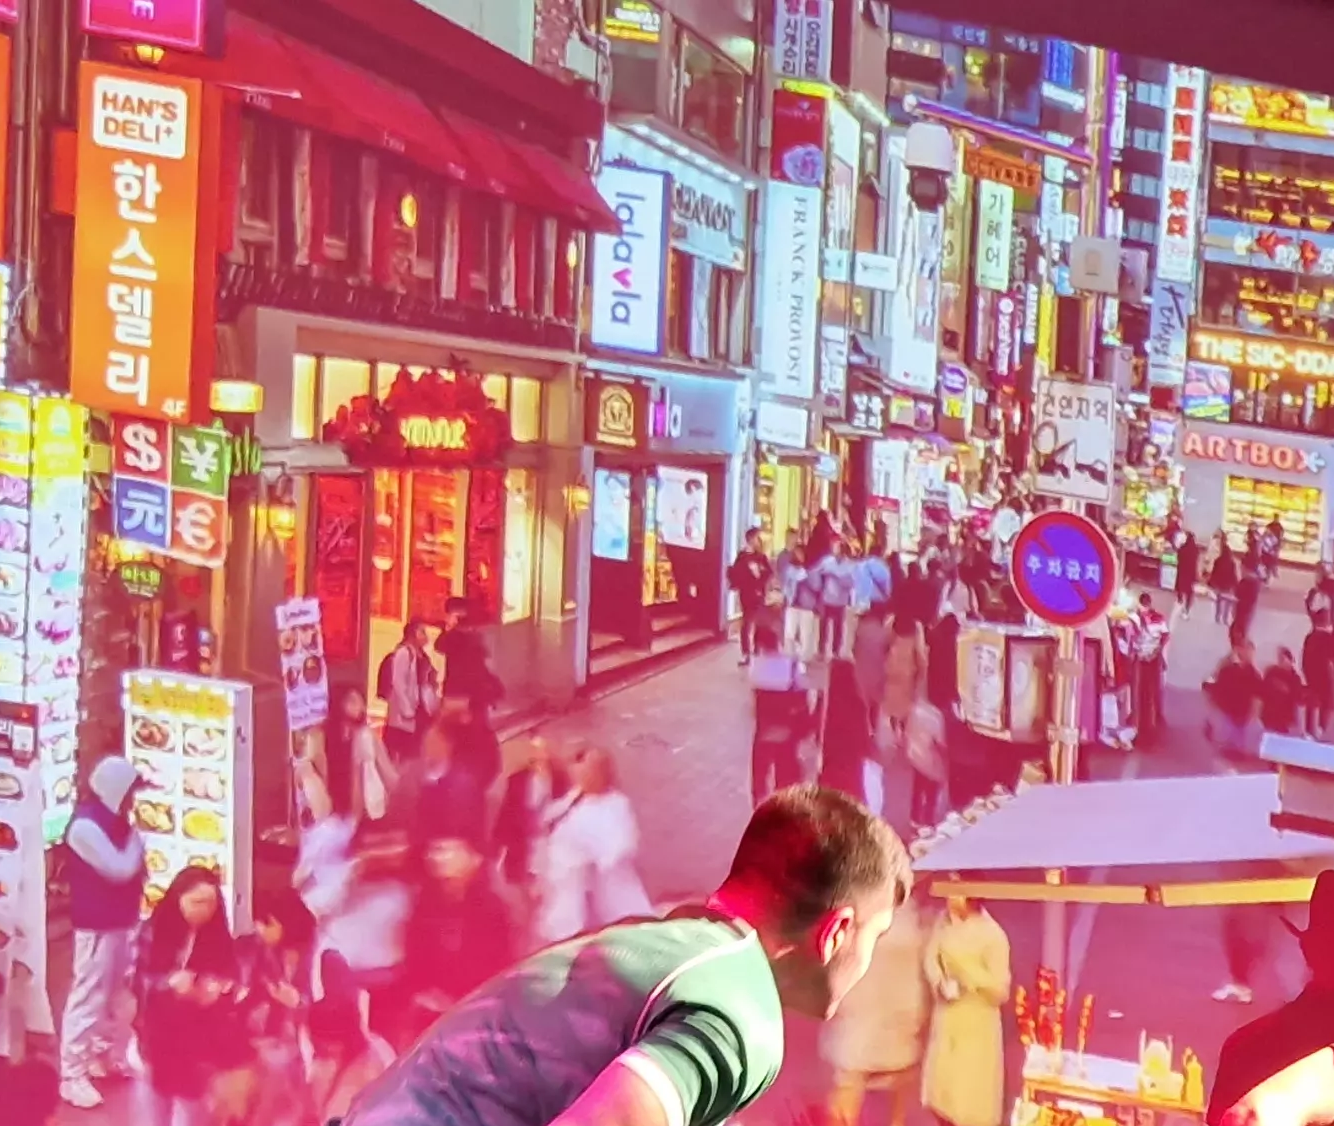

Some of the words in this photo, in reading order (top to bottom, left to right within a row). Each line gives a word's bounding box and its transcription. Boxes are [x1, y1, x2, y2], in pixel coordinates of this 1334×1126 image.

[101, 89, 179, 123] HAN'S
[104, 158, 163, 407] 한스델리
[1195, 335, 1243, 364] THE
[122, 422, 162, 472] $
[178, 434, 220, 483] ¥
